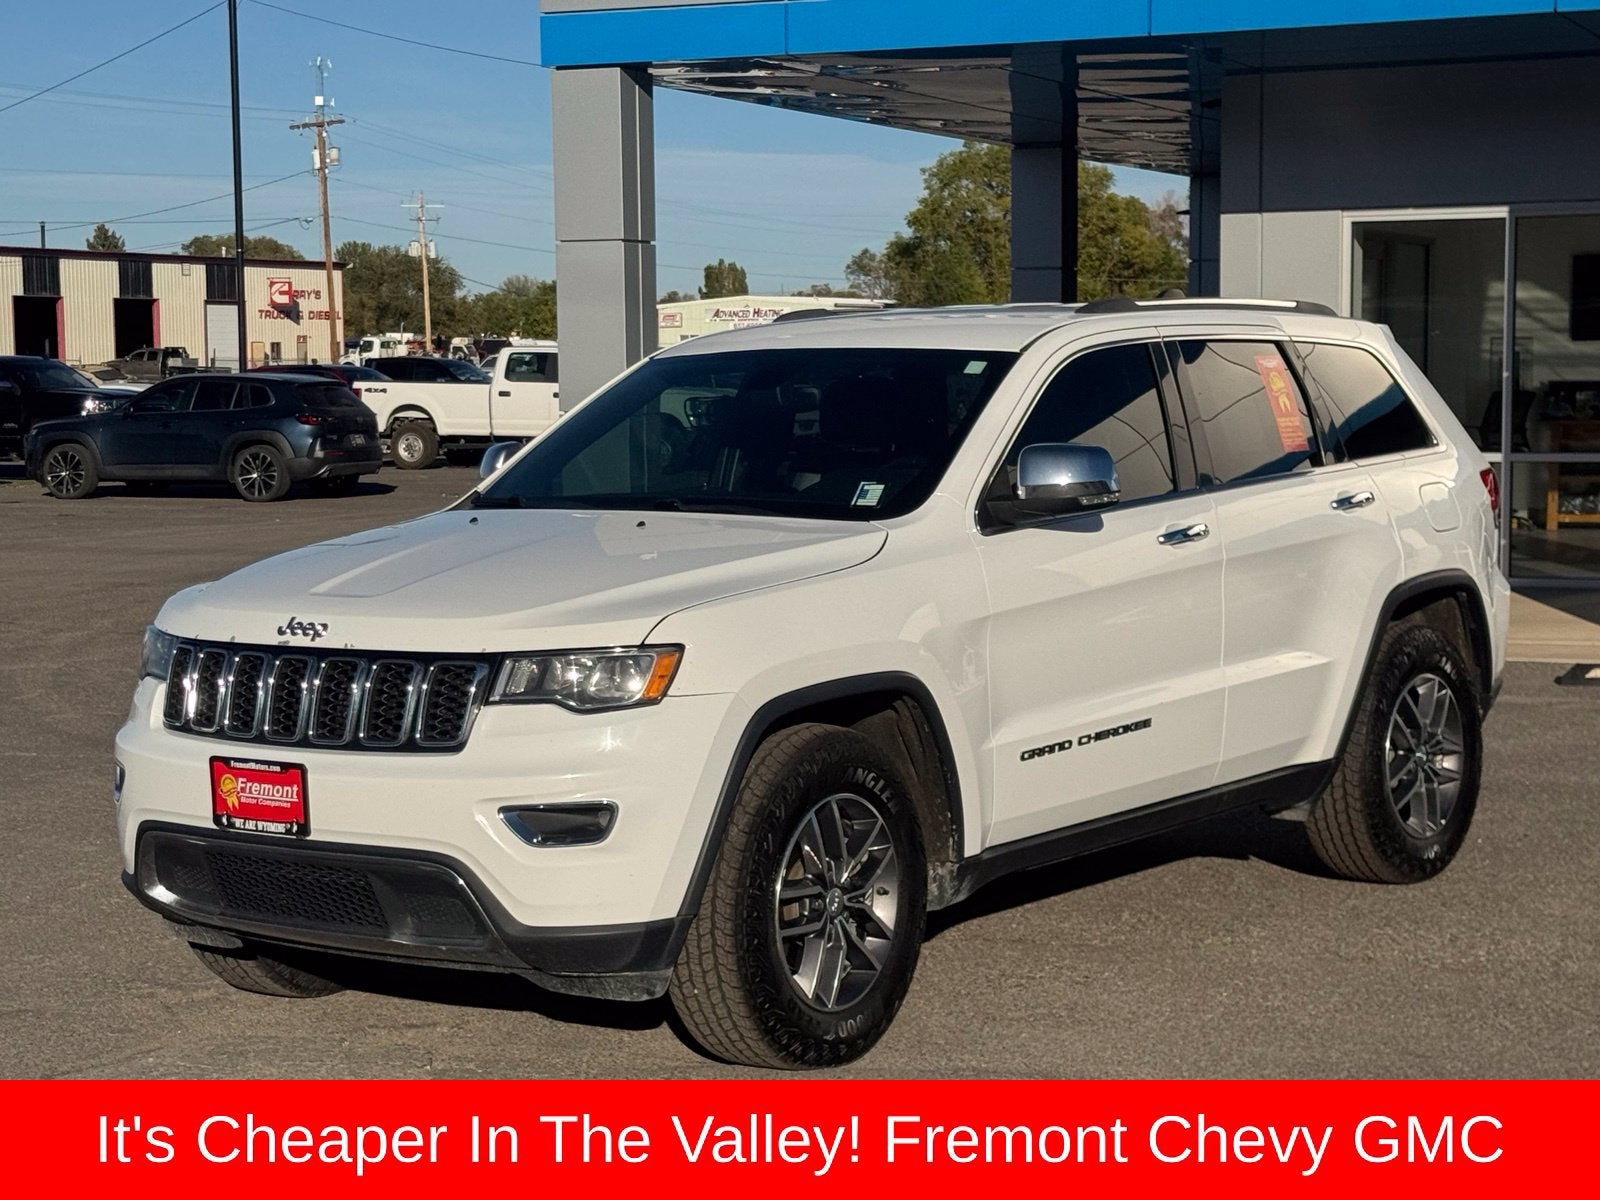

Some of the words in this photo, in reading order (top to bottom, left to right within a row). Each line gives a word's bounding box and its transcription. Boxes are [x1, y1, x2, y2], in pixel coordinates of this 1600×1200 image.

[308, 310, 341, 320] DIESL
[712, 308, 750, 319] ADVANCED
[277, 616, 329, 642] Jeep
[1020, 739, 1073, 762] GRAND
[1077, 717, 1153, 747] CHEROKEE
[238, 777, 299, 799] Fremont
[240, 796, 257, 804] Motor
[258, 798, 291, 809] Companies
[245, 819, 256, 830] ARE
